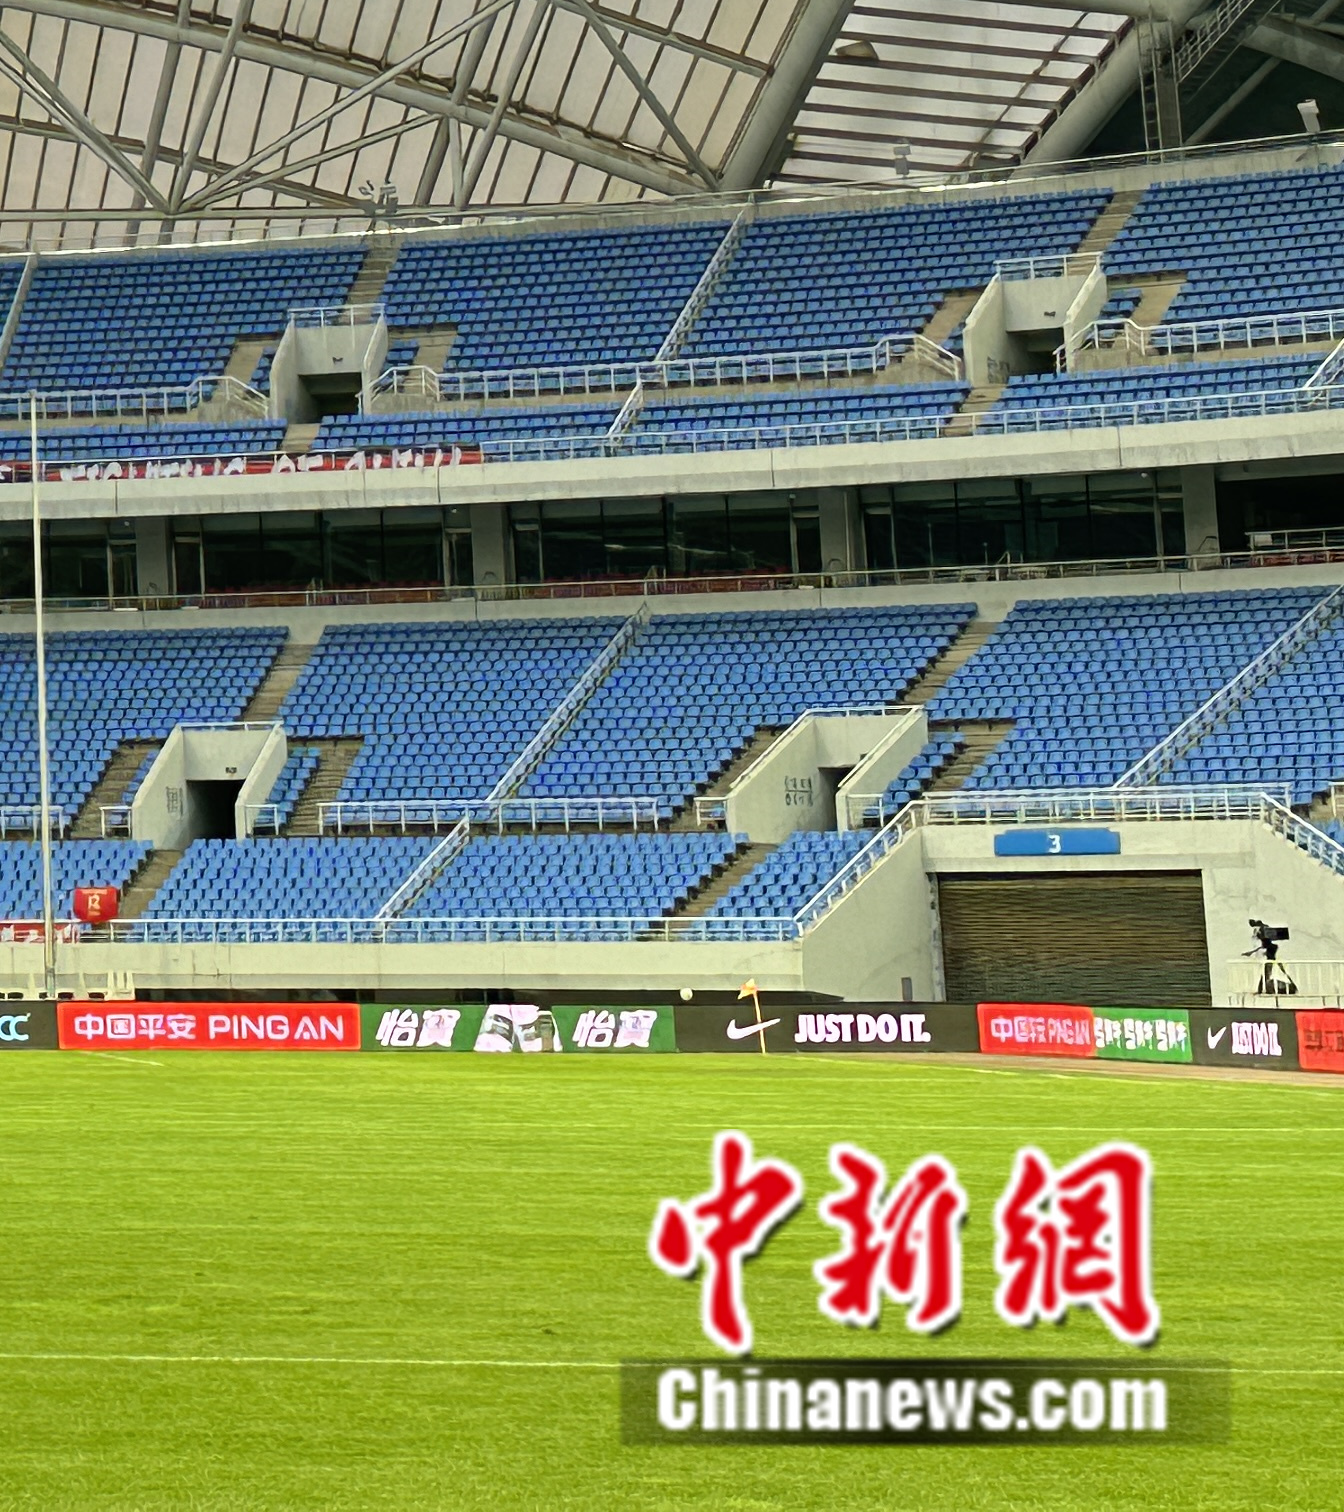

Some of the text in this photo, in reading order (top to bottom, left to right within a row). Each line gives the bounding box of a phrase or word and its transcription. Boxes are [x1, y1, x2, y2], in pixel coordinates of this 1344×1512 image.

[1048, 834, 1061, 854] 3
[74, 1013, 196, 1040] 中国平安
[794, 1013, 853, 1043] JUST
[856, 1013, 897, 1042] DO
